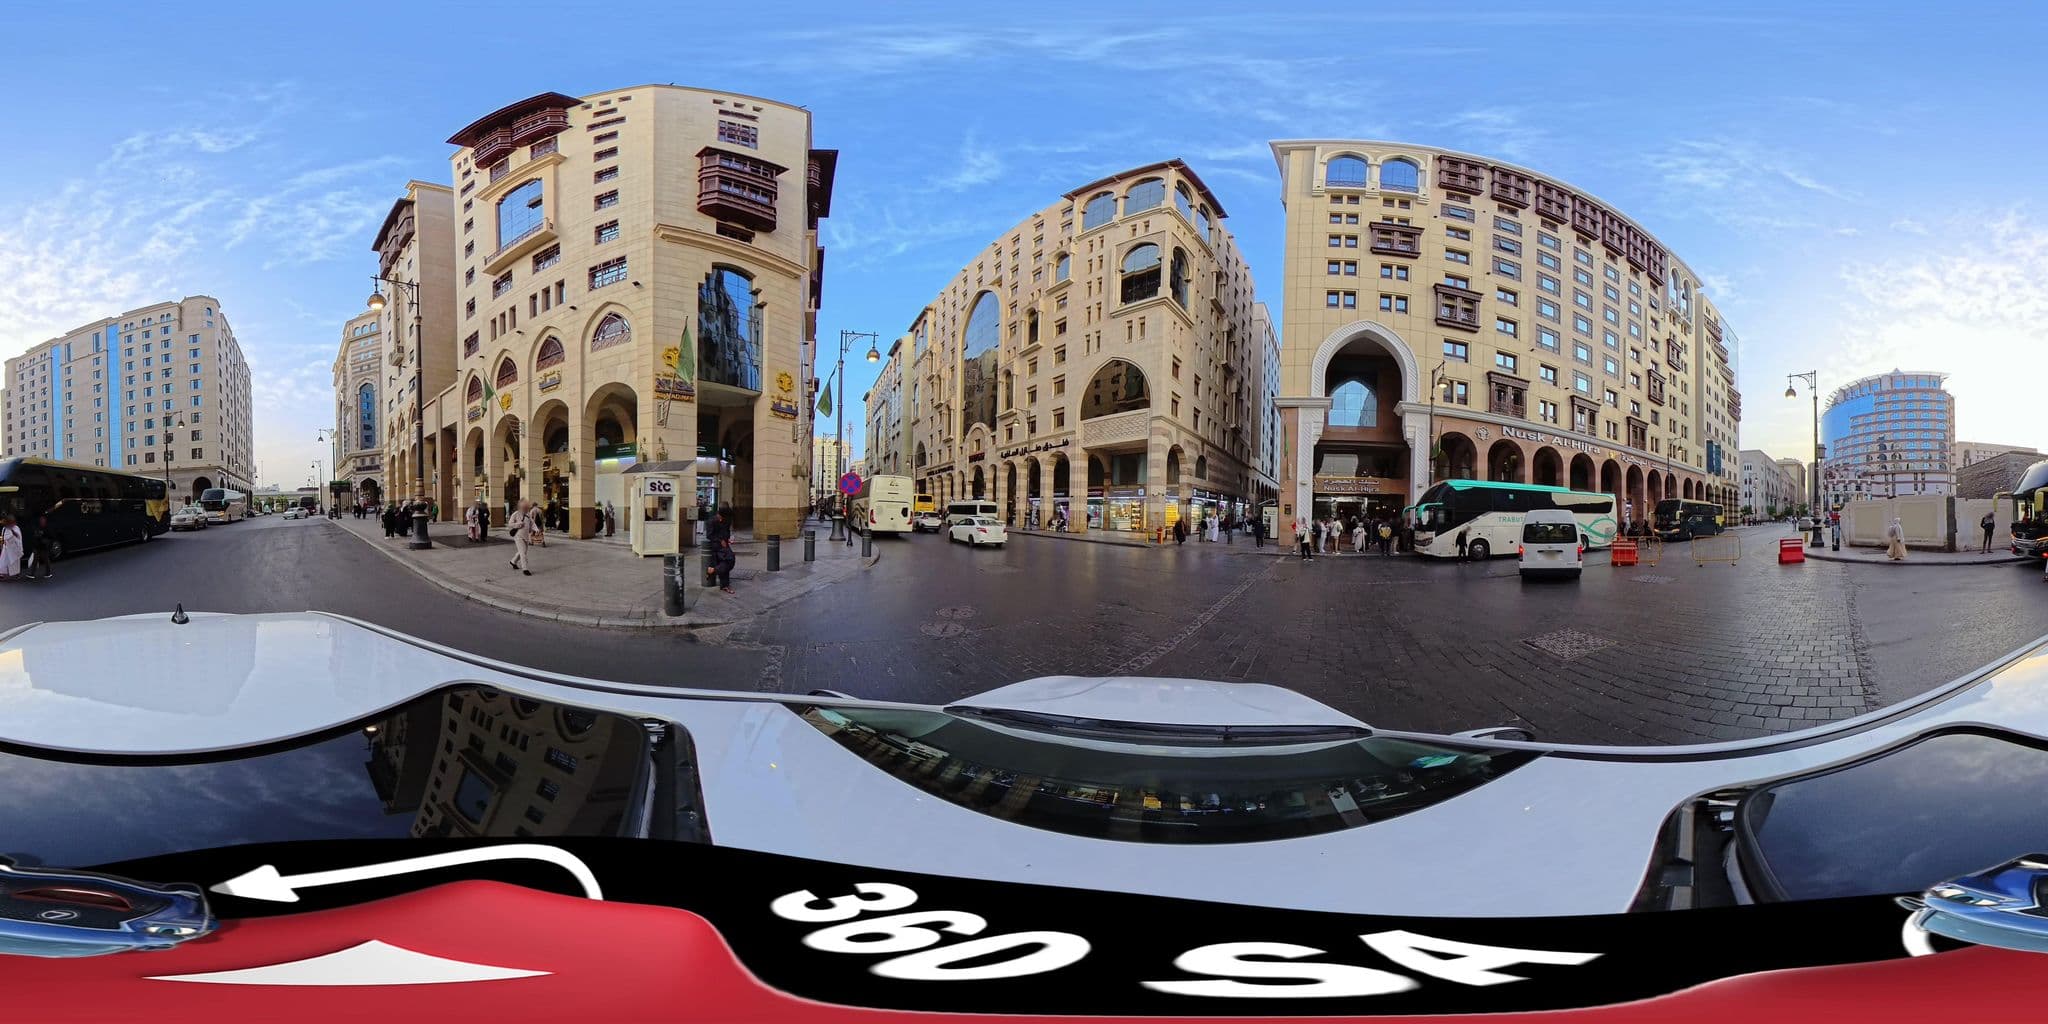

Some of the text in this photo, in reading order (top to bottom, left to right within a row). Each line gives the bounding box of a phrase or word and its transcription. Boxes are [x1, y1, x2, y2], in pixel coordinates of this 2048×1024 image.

[1043, 438, 1070, 452] فندق
[1502, 426, 1601, 454] Nusk Al-Hijra
[650, 480, 671, 492] stc
